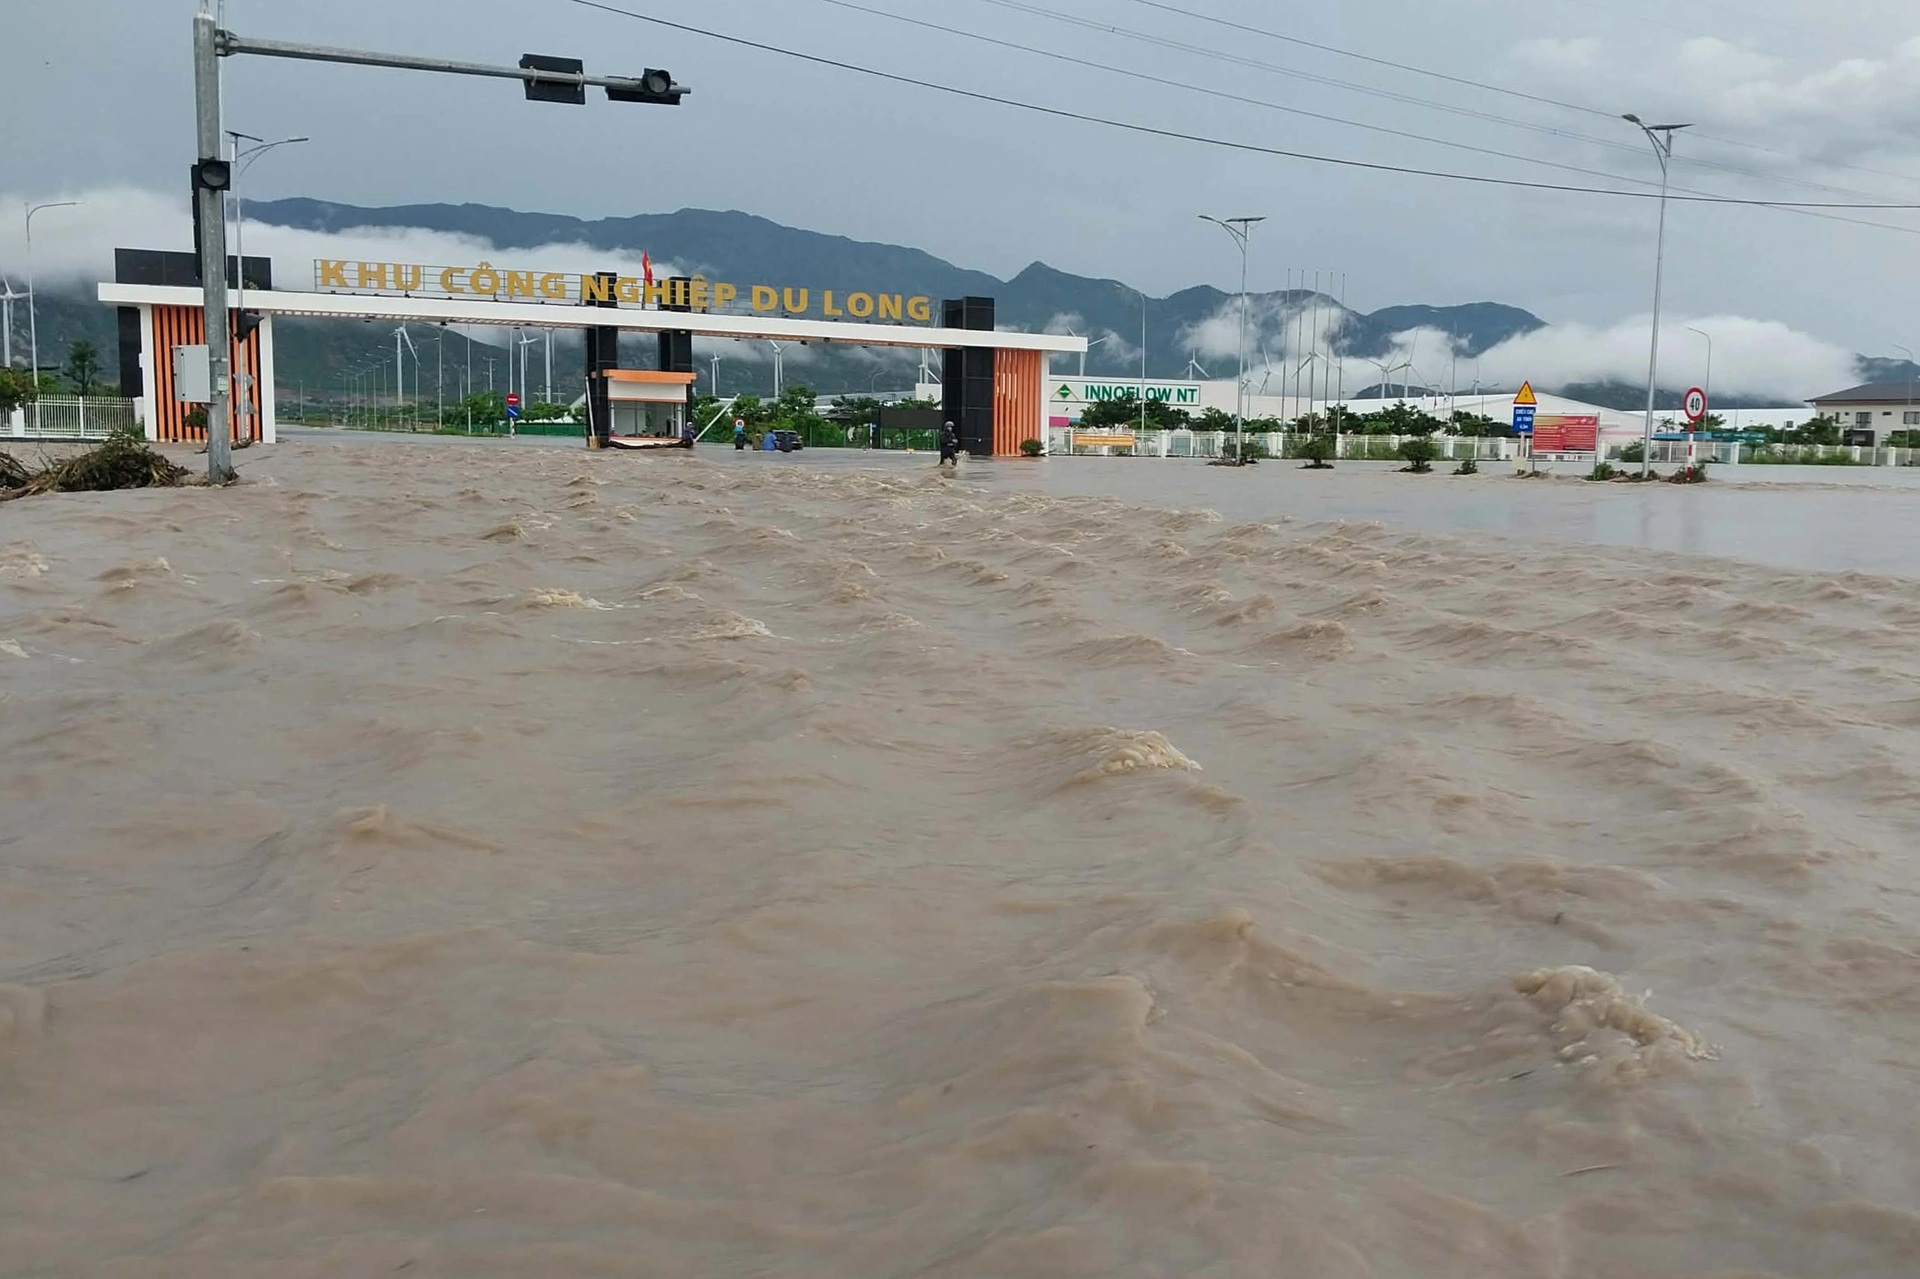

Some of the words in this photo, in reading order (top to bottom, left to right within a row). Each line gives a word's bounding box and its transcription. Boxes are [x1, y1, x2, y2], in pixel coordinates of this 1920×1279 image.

[320, 259, 421, 291] KHU
[440, 261, 566, 298] CÔNG
[581, 273, 737, 313] NGHIỆP
[752, 285, 809, 313] DU
[824, 289, 931, 321] LONG
[1177, 388, 1197, 402] NT
[1690, 397, 1700, 411] 40
